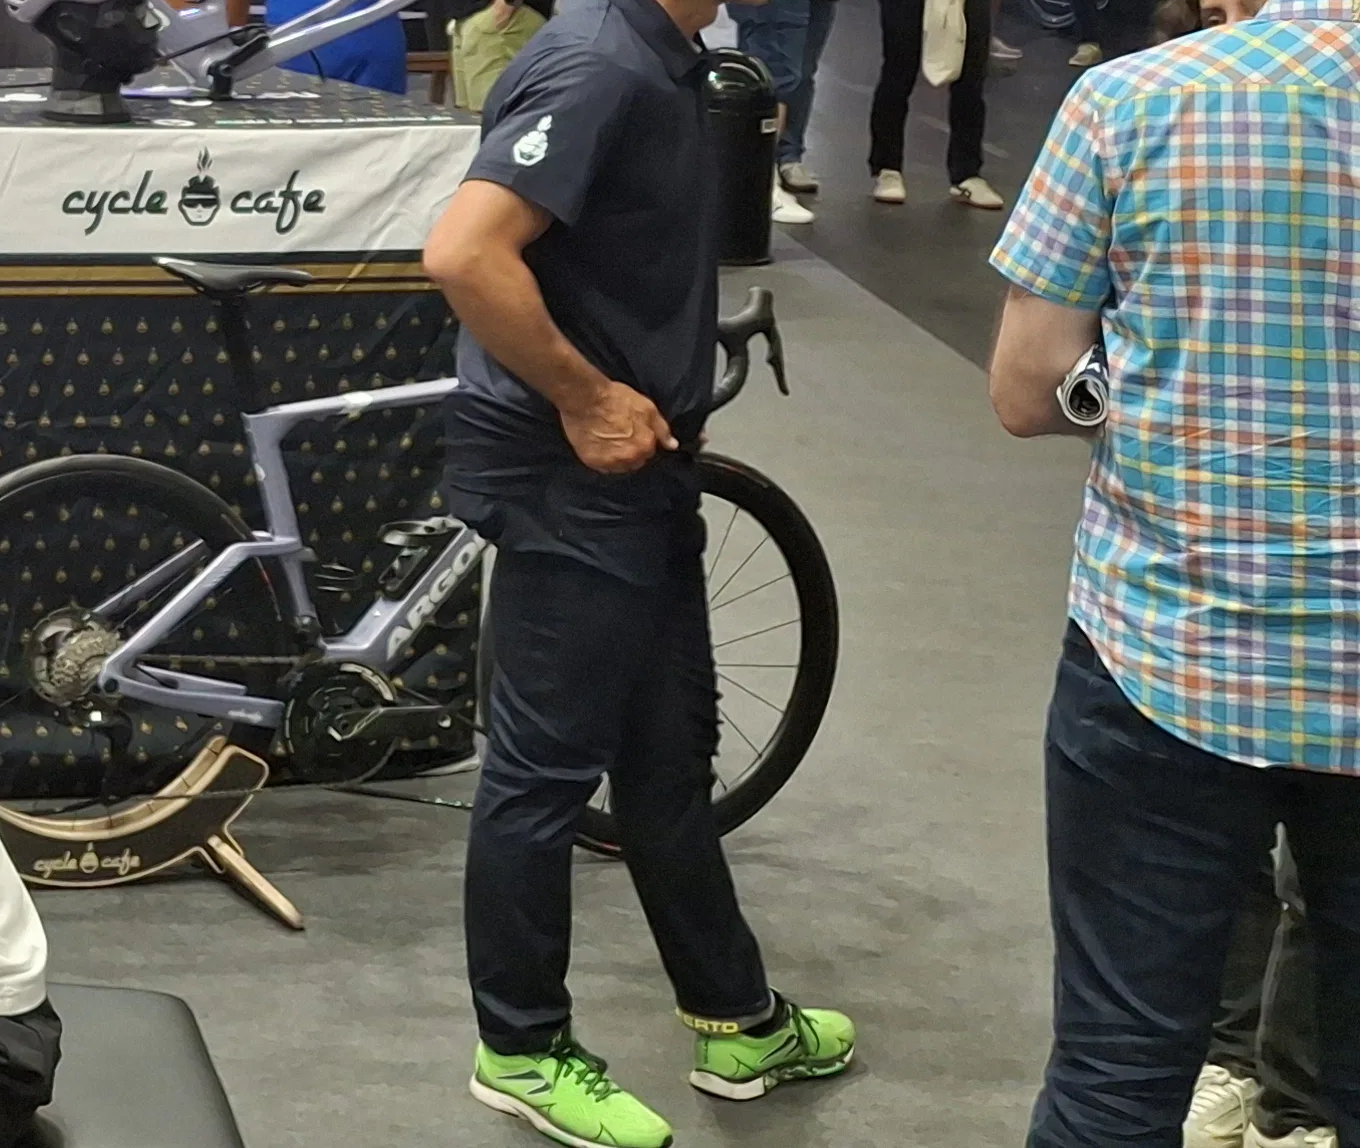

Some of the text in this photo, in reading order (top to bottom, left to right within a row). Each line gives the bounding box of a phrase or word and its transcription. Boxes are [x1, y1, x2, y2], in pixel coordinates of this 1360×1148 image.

[62, 169, 327, 236] cycle cafe
[34, 848, 140, 879] cycle cafe
